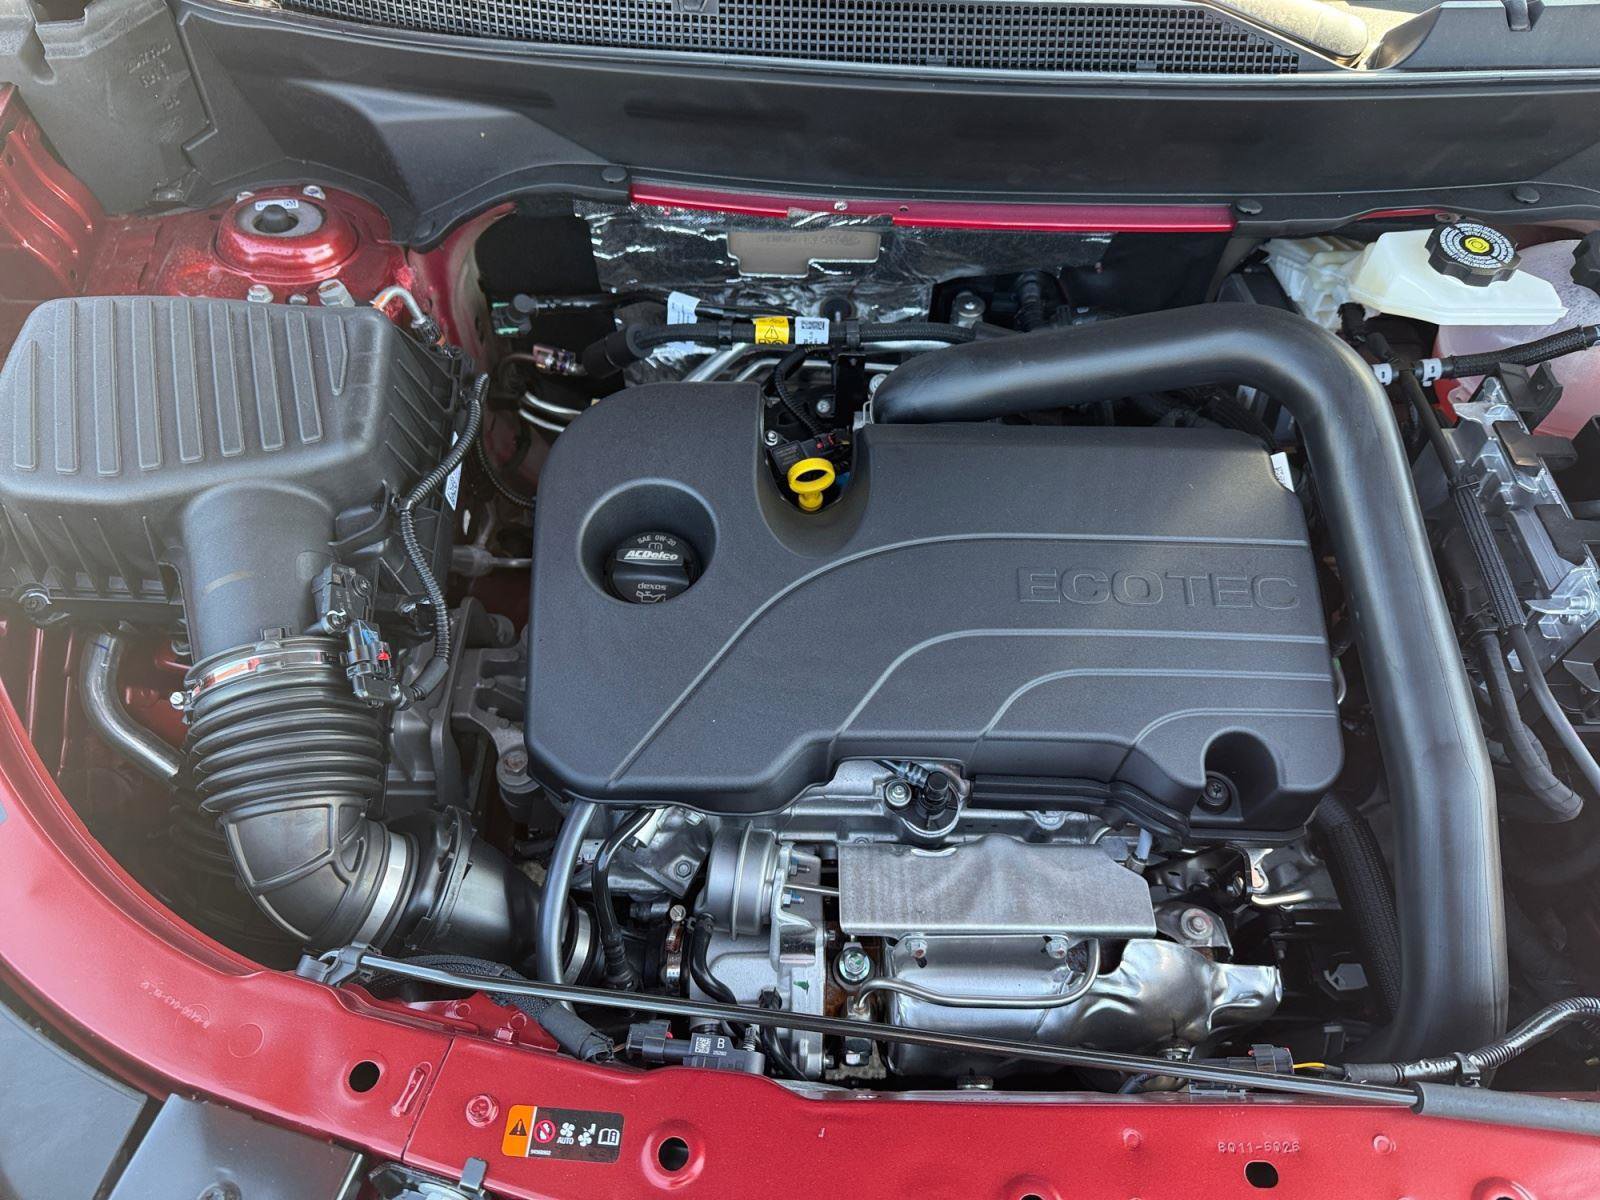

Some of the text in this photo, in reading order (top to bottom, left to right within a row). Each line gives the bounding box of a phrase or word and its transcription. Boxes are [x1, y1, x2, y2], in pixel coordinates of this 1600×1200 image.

[637, 534, 677, 547] SAE 0W-20
[623, 550, 679, 560] ACDelco
[637, 582, 667, 590] dexos
[1016, 566, 1299, 610] ECOTEC
[717, 1037, 725, 1049] B
[556, 1136, 575, 1145] AUTO
